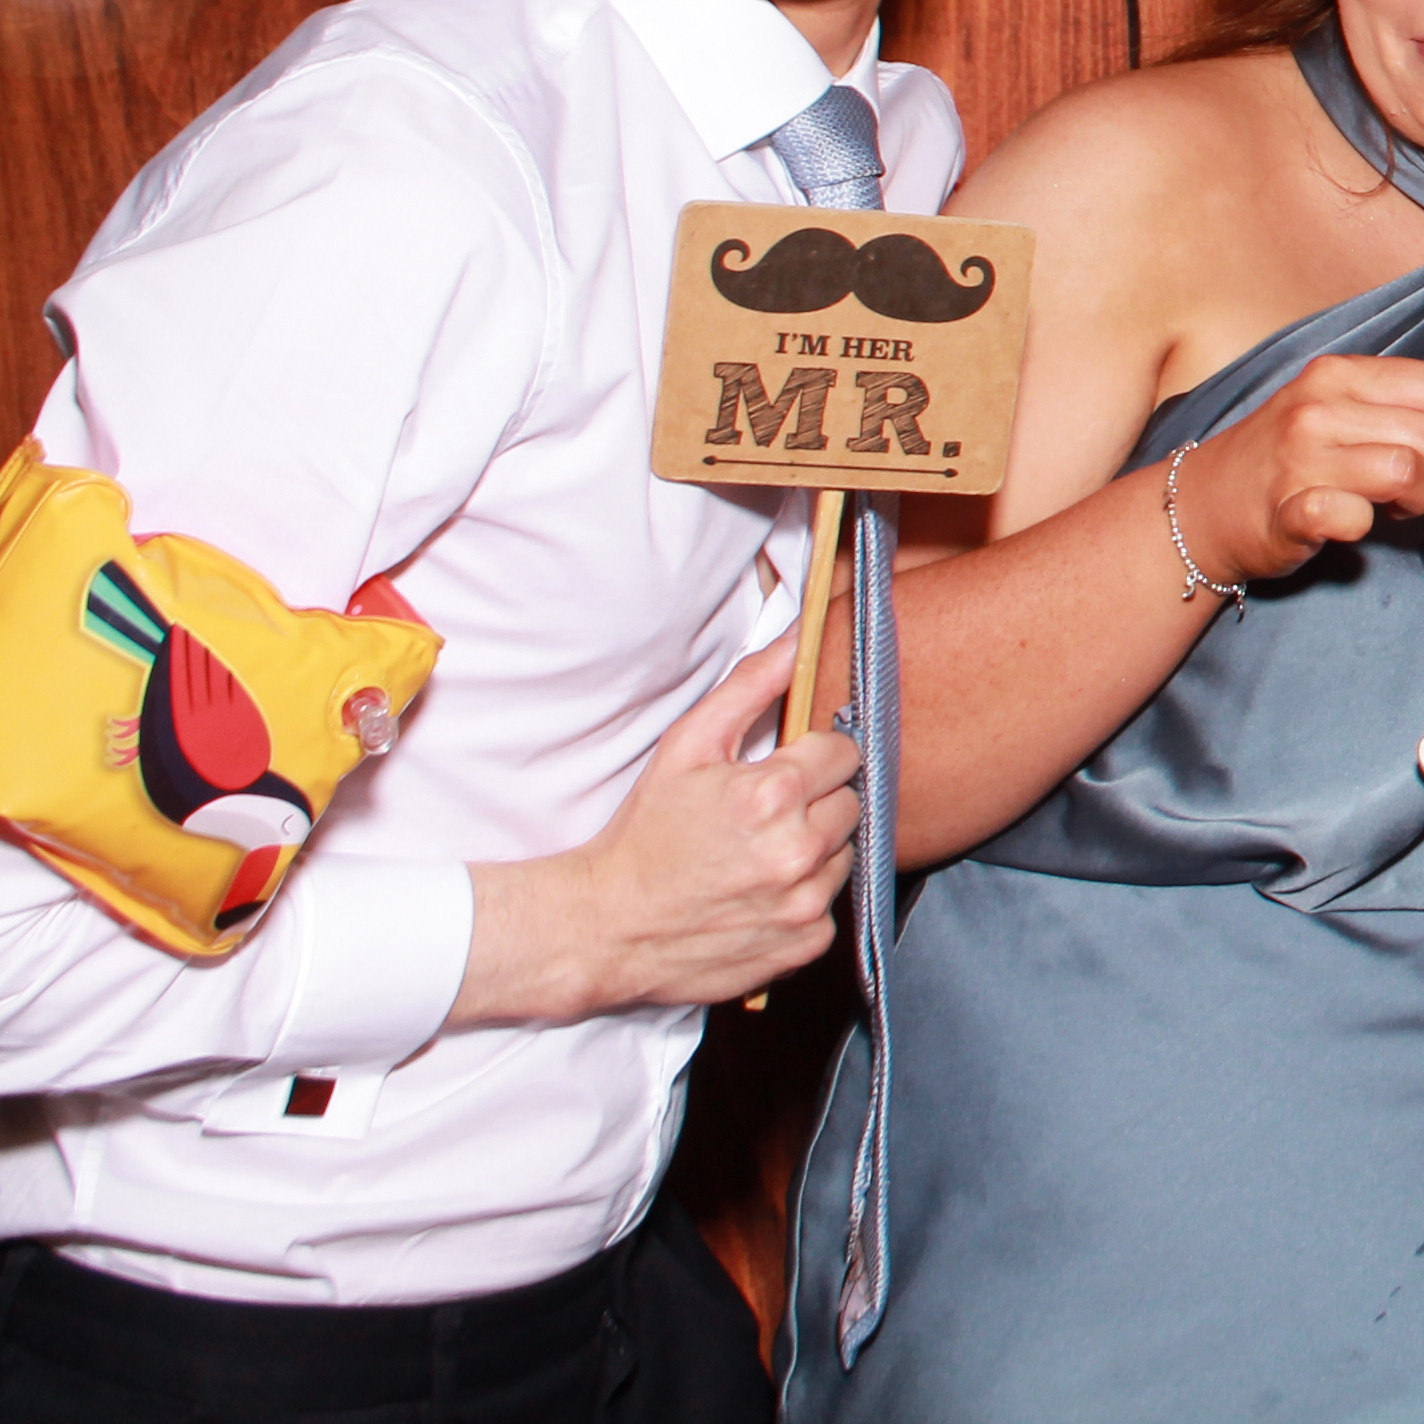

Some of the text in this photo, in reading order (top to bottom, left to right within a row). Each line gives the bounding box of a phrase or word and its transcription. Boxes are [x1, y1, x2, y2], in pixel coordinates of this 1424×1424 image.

[774, 332, 915, 362] I'M HER
[705, 362, 962, 458] MR.
